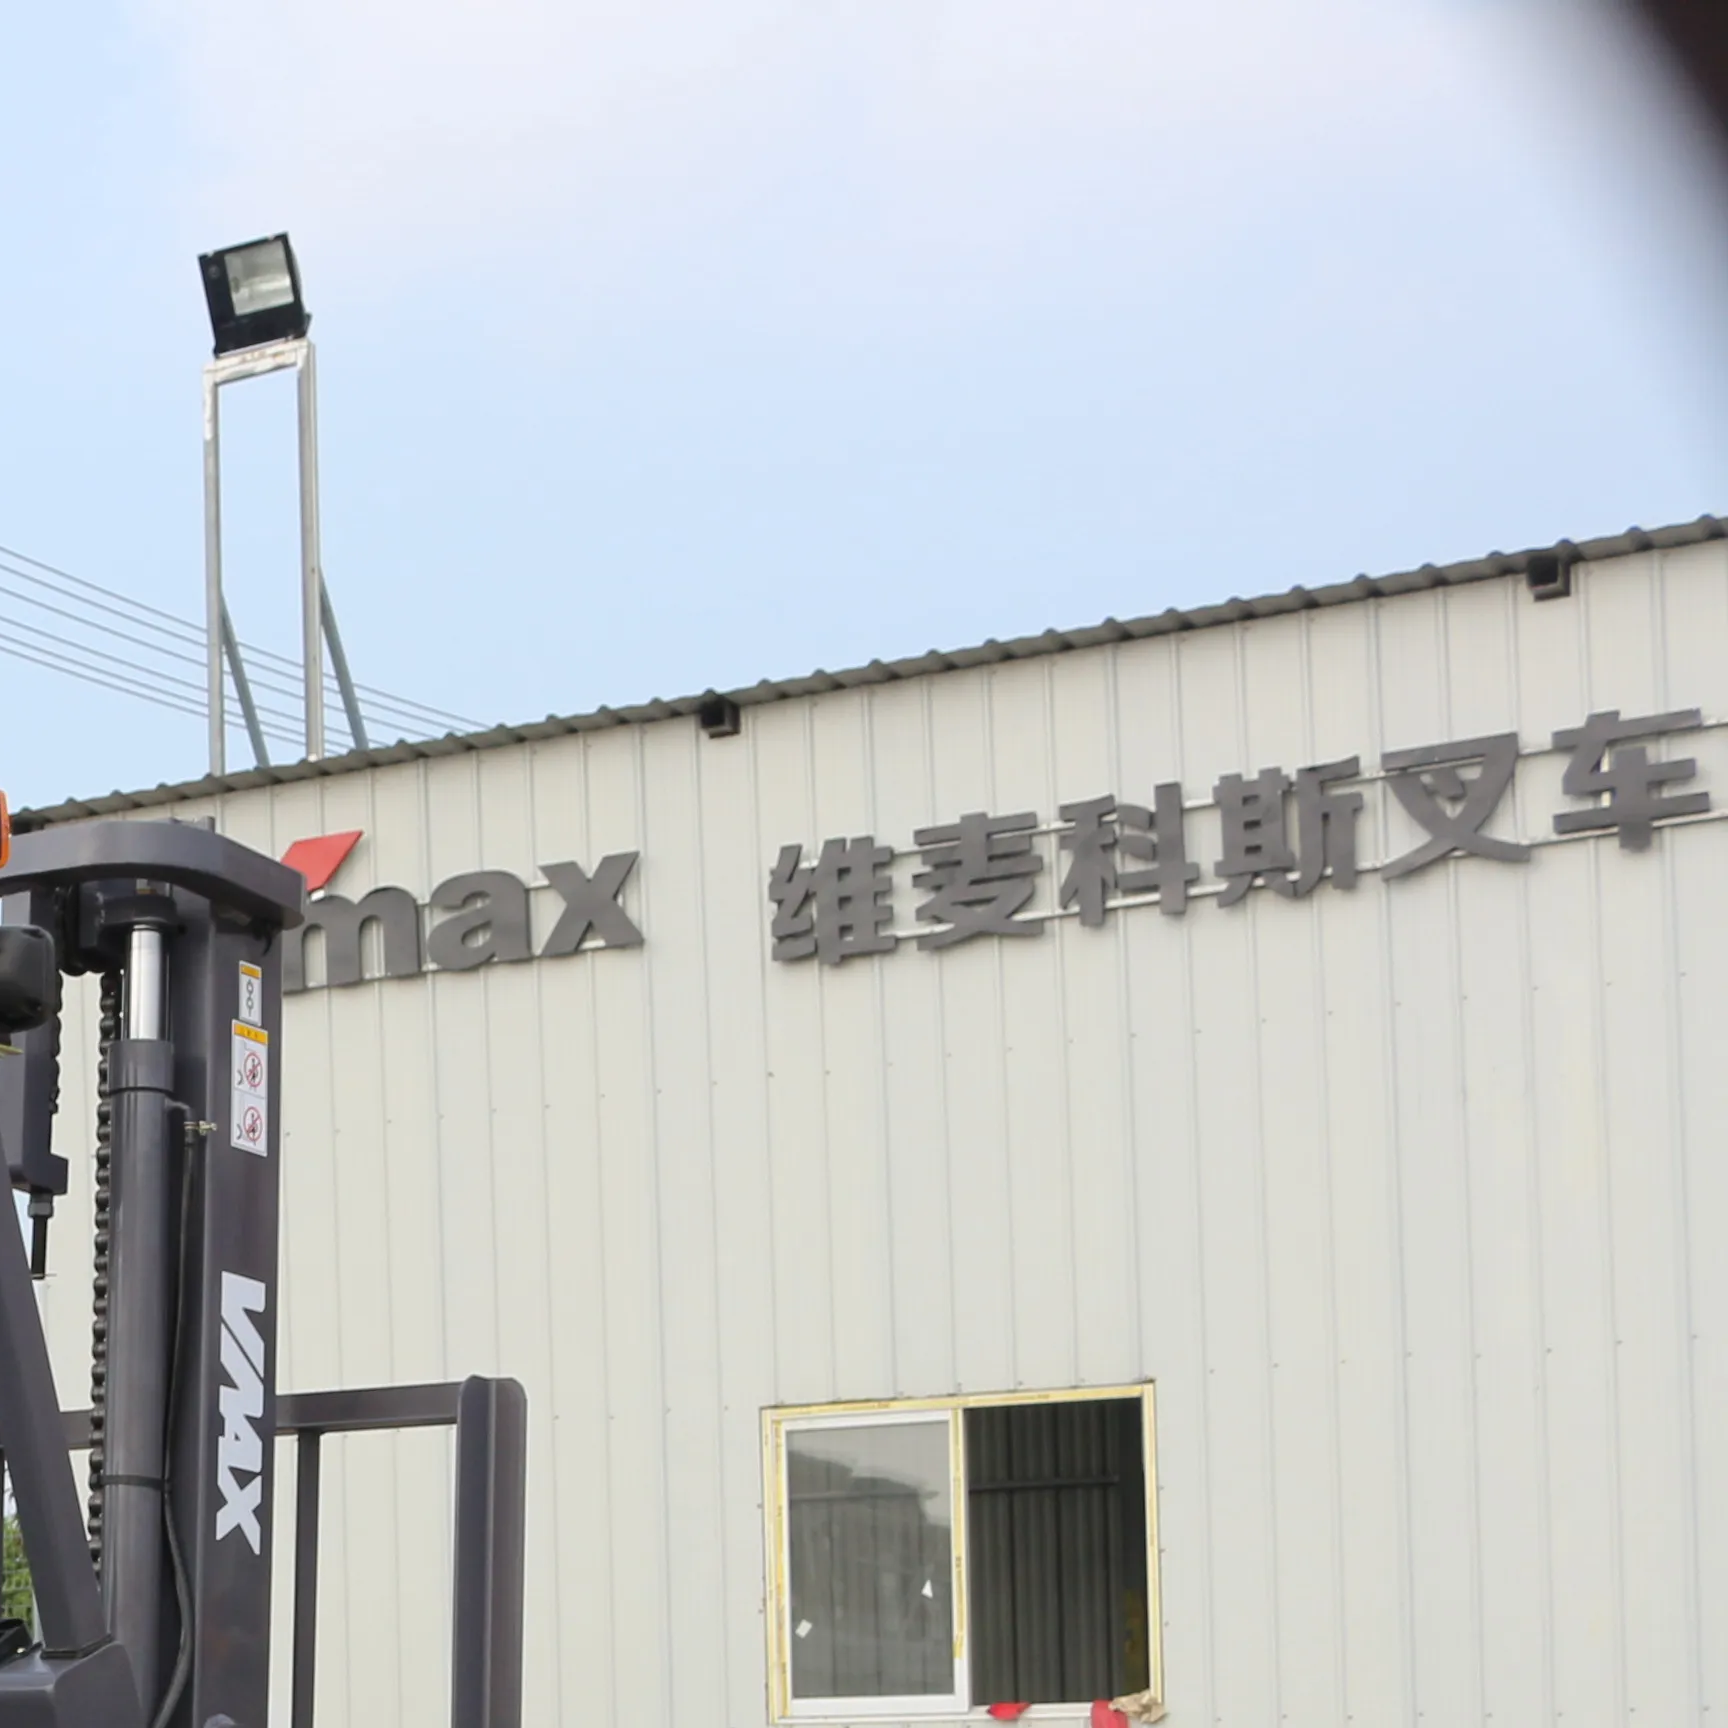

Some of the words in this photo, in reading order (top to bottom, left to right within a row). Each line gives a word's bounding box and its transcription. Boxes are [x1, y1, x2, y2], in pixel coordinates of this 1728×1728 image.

[769, 708, 1711, 965] 维麦科斯叉车
[216, 1270, 266, 1556] VMAX
